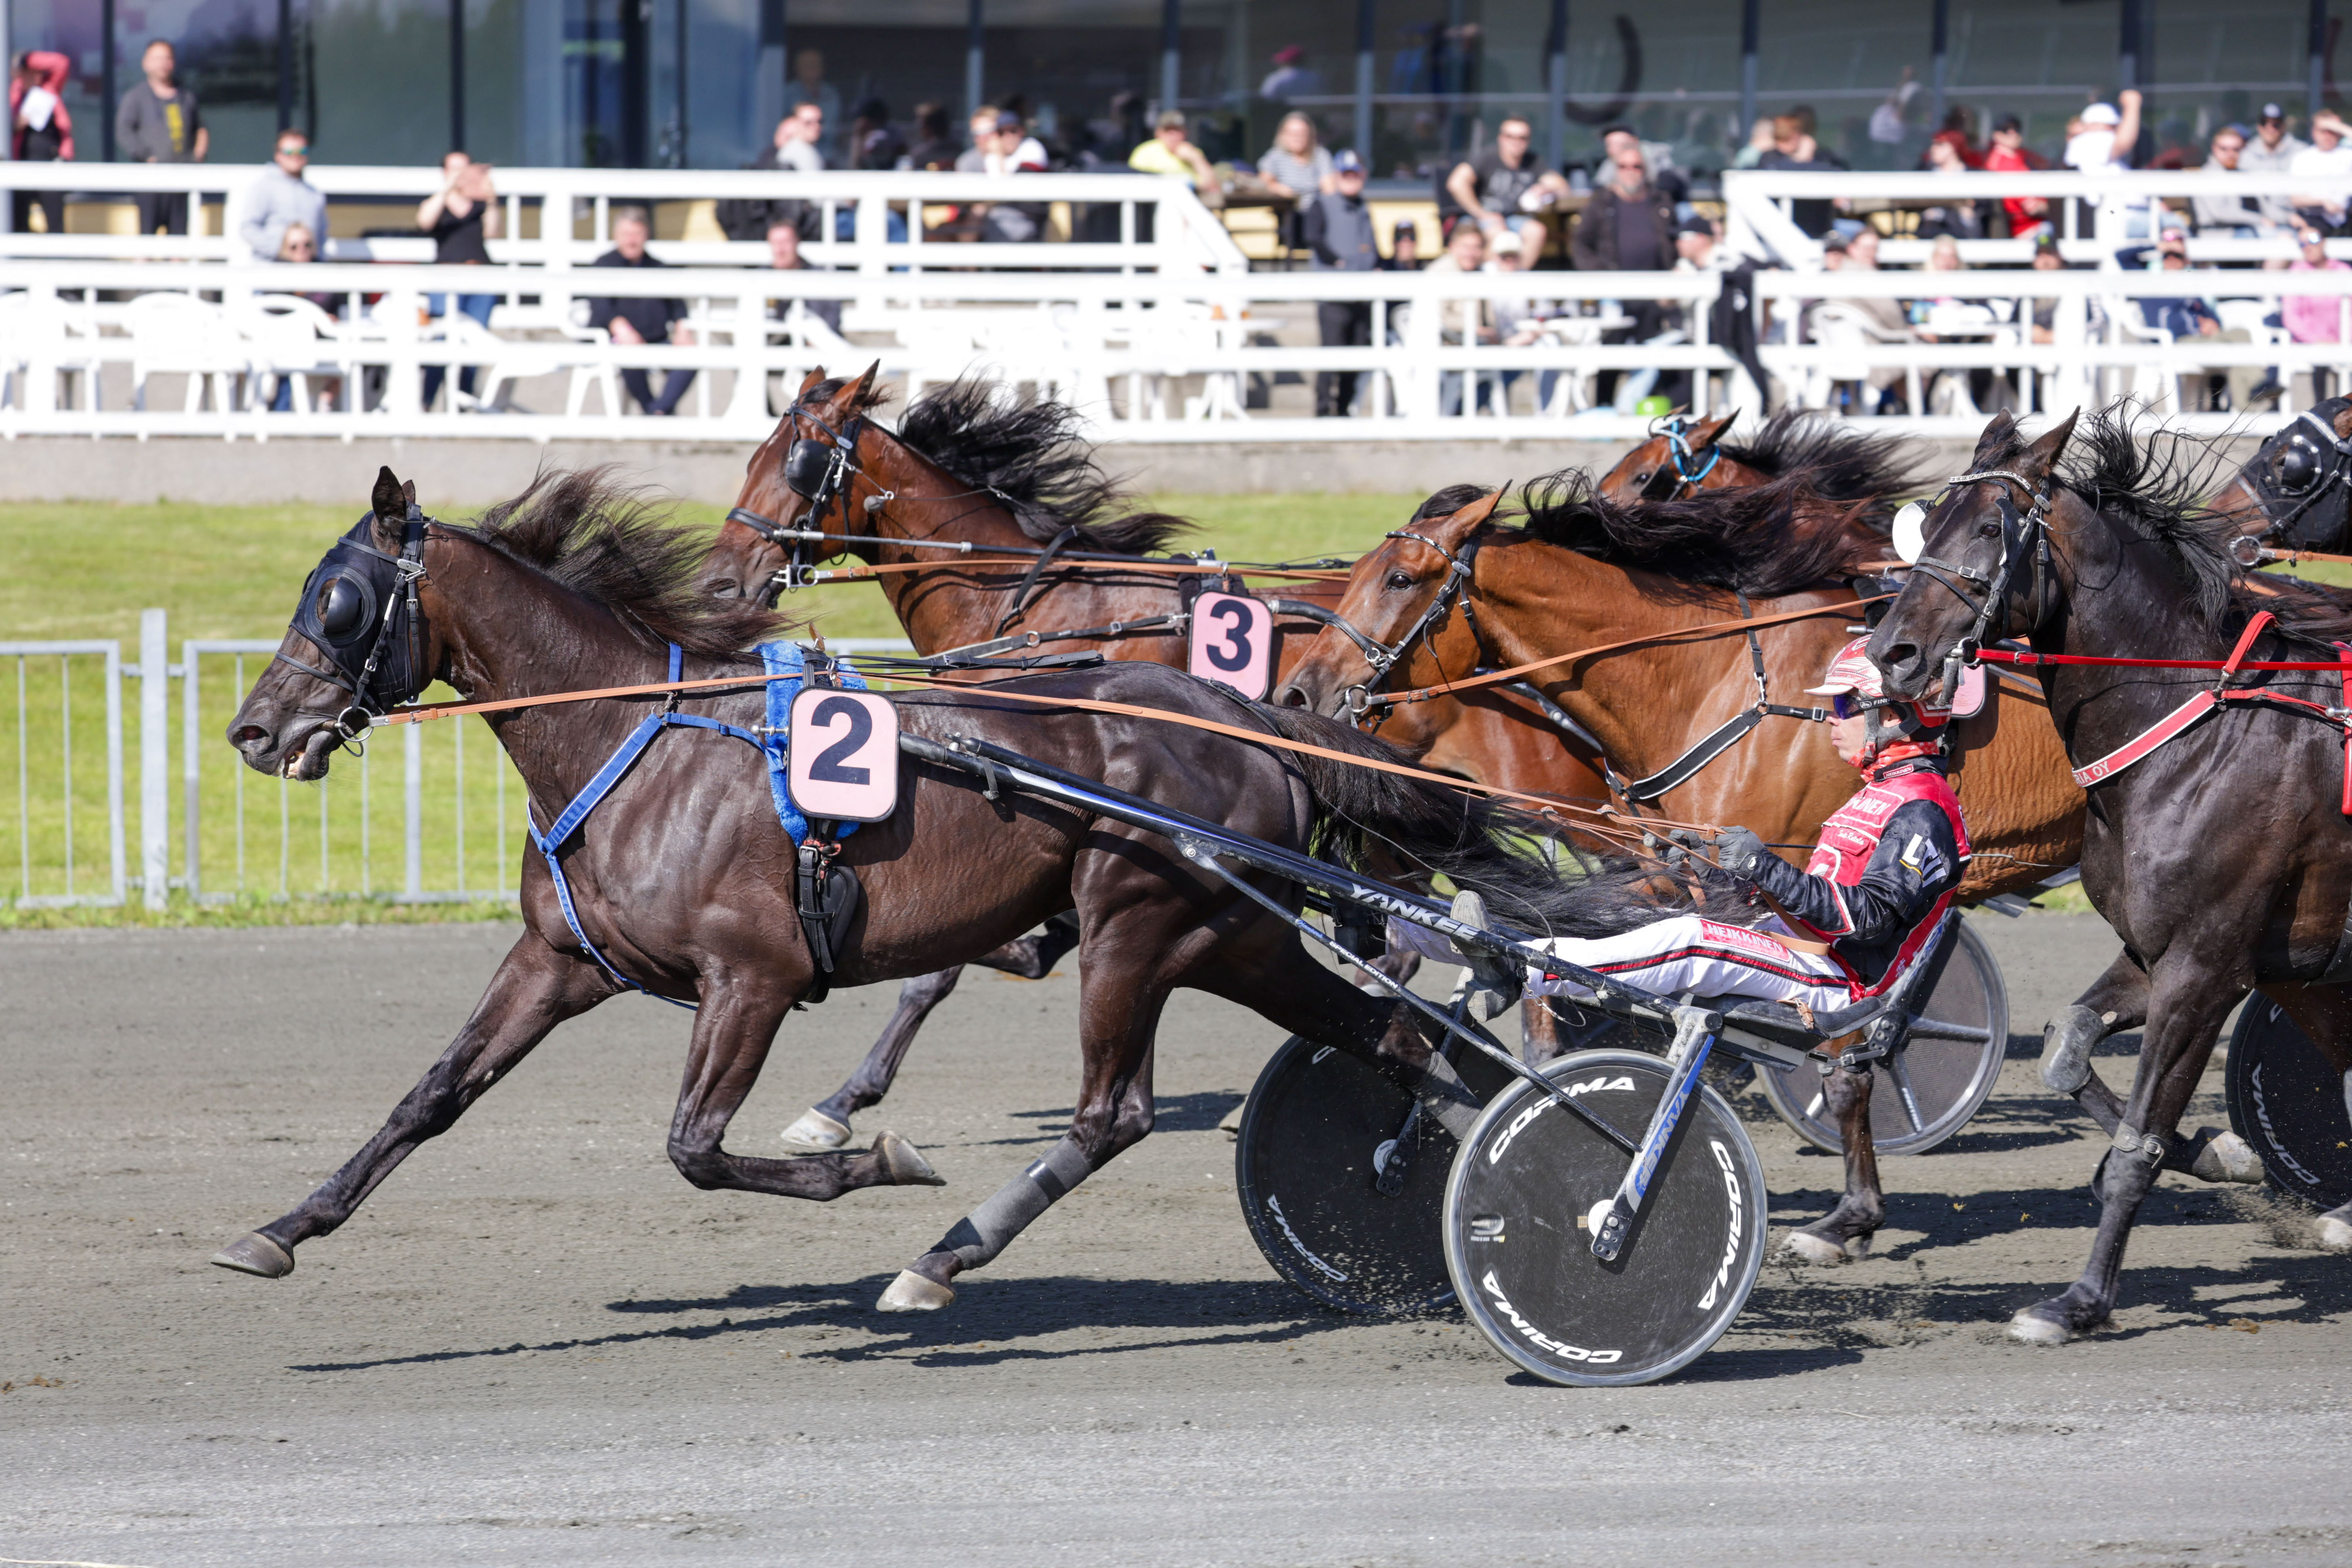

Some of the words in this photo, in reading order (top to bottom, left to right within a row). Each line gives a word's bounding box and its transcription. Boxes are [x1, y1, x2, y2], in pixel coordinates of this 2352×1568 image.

[1206, 599, 1253, 672] 3
[809, 696, 872, 785] 2
[1016, 770, 1036, 779] CARBON
[1885, 766, 1912, 777] HEIKKINEN
[2092, 761, 2109, 777] OY
[1351, 883, 1481, 940] YANKEE
[1706, 923, 1783, 953] HEIKKINEN
[1329, 940, 1364, 967] SPECIAL
[1363, 964, 1399, 990] EDITION
[1639, 1091, 1690, 1191] YANKEE
[2251, 1061, 2322, 1185] CORIMA
[1267, 1193, 1348, 1282] CORIMA
[1697, 1140, 1742, 1311] CORIMA
[1483, 1270, 1623, 1363] CORIMA
